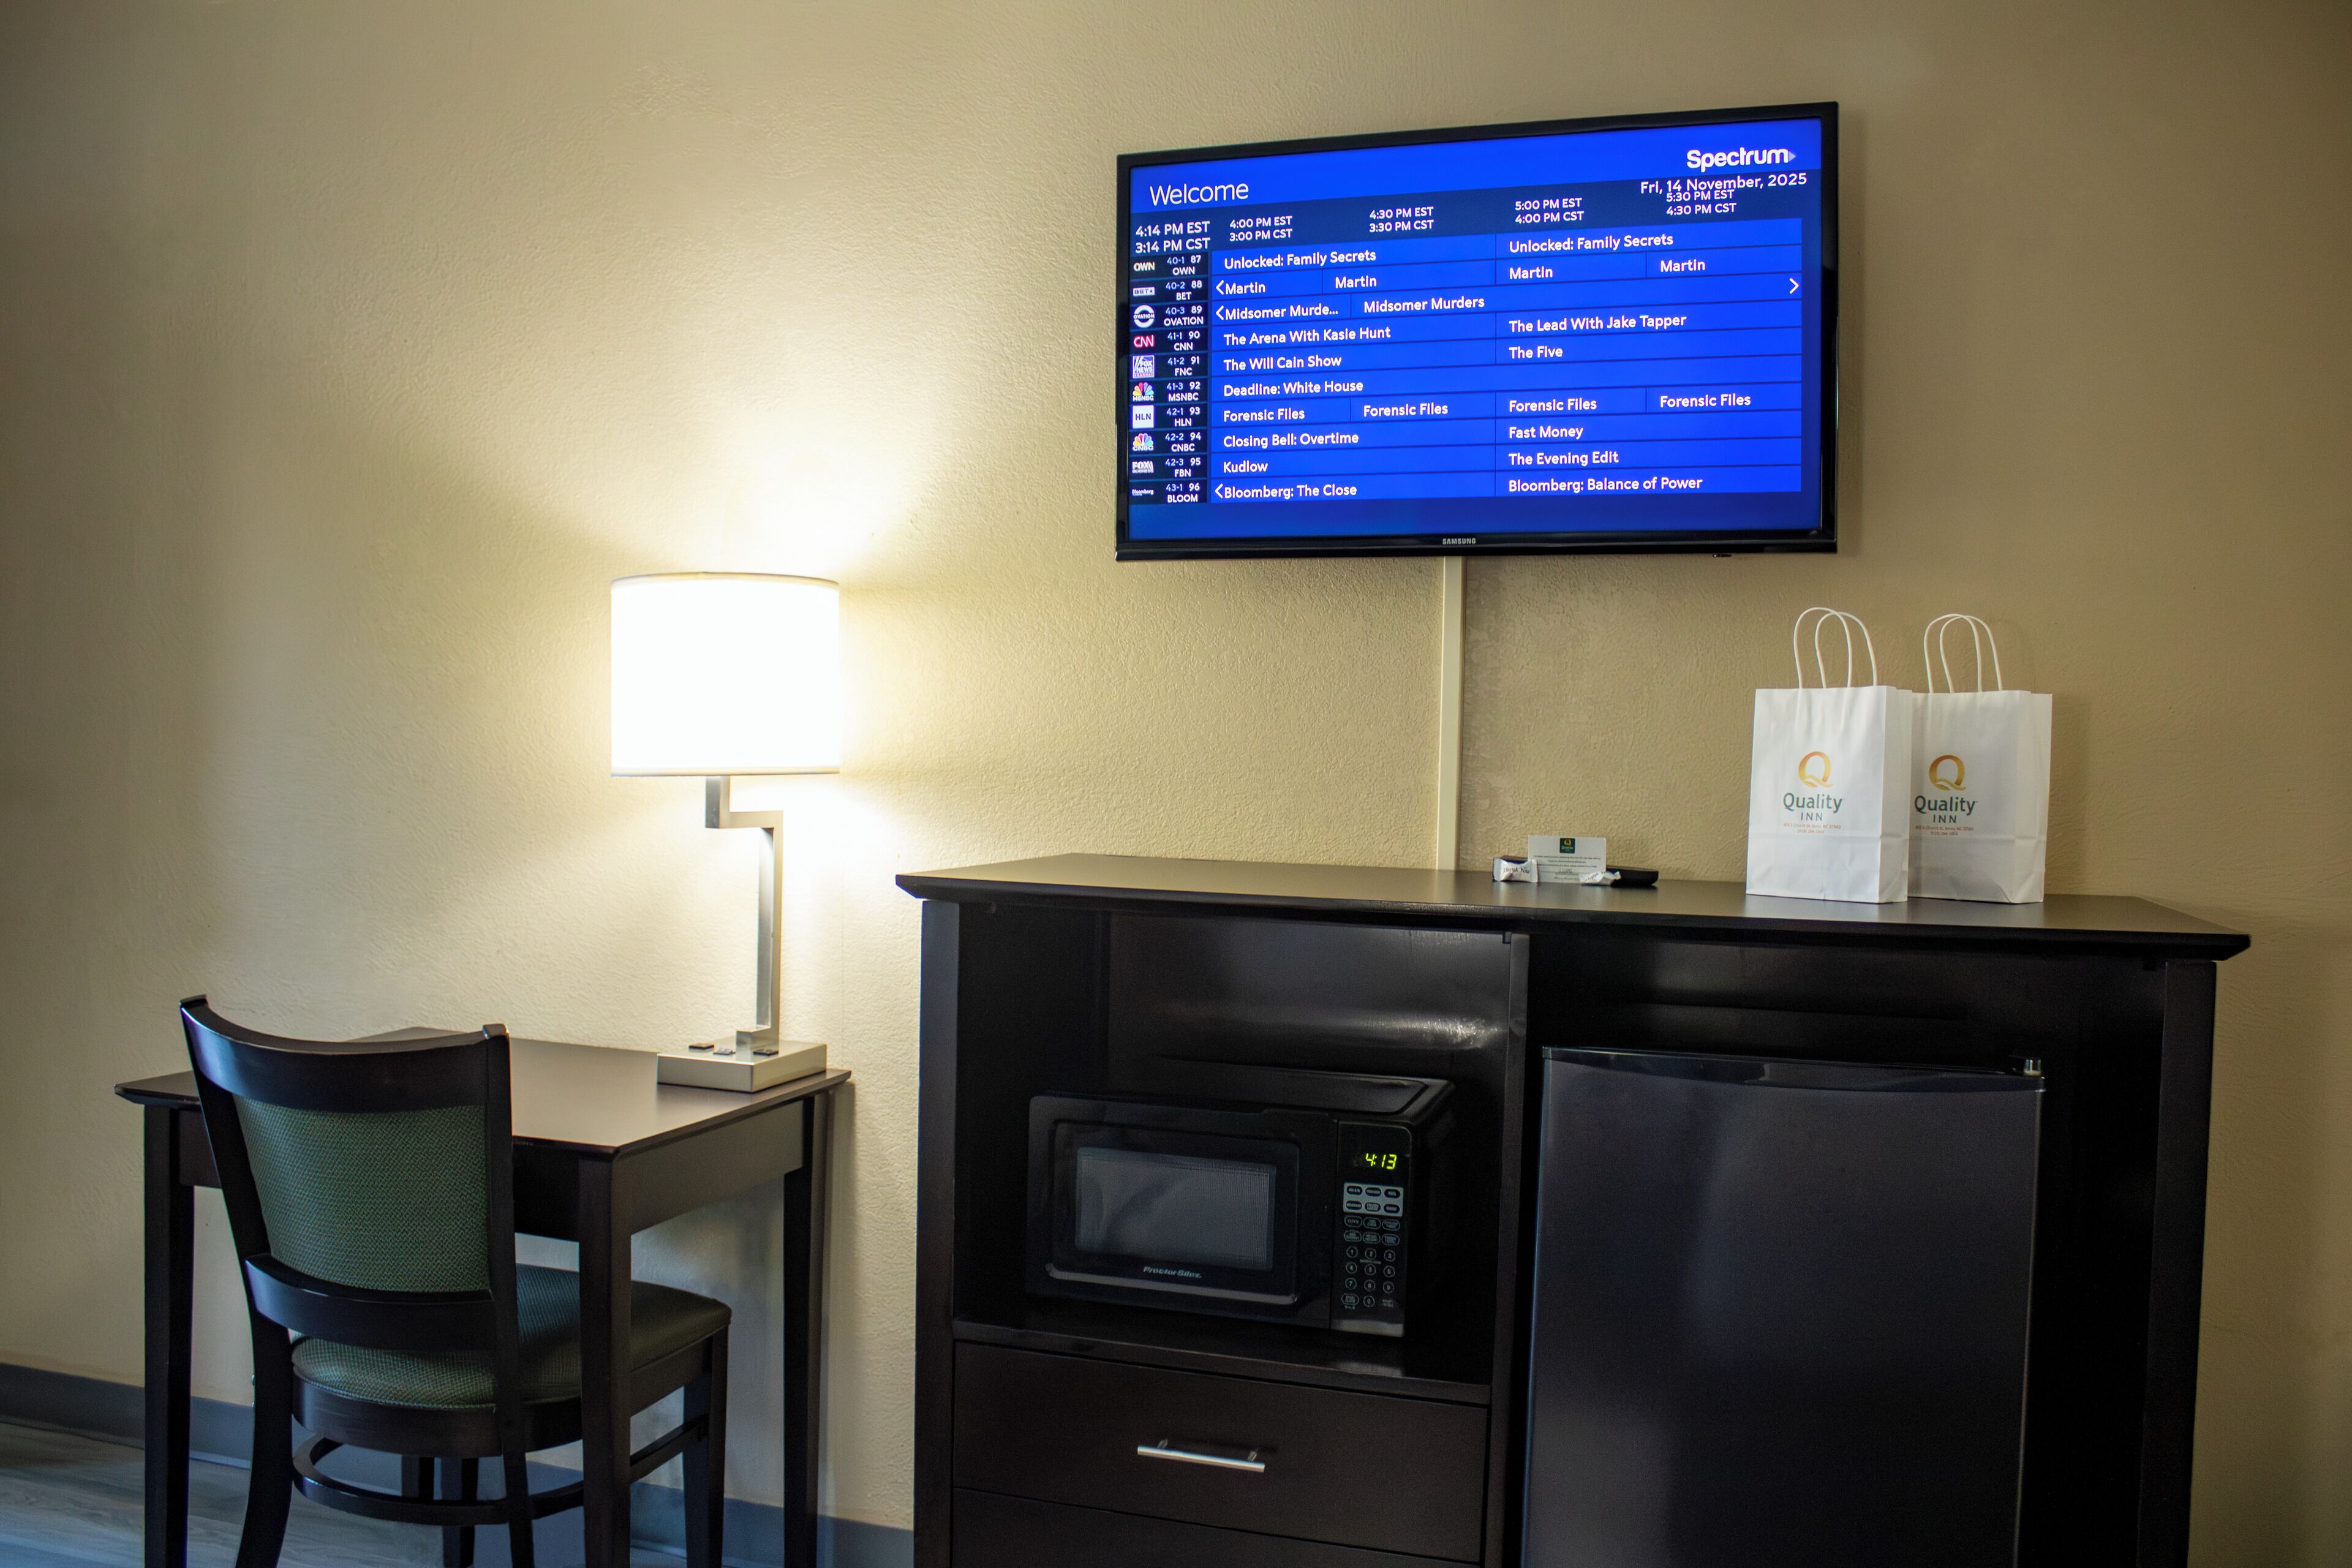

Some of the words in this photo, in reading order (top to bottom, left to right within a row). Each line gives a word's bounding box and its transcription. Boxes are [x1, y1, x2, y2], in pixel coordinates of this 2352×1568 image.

[1687, 147, 1789, 173] Spectrum
[1641, 181, 1662, 195] Fri,
[1667, 179, 1682, 192] 14
[1687, 175, 1763, 191] November,
[1768, 173, 1807, 187] 2025
[1150, 183, 1249, 206] Welcome
[1666, 191, 1691, 202] 5:30
[1694, 190, 1711, 201] PM
[1714, 189, 1735, 200] EST
[1515, 200, 1540, 211] 5:00
[1543, 198, 1559, 209] PM
[1562, 197, 1582, 208] EST
[1666, 205, 1692, 216] 4:30
[1695, 204, 1711, 214] PM
[1714, 203, 1736, 213] CST
[1369, 209, 1393, 219] 4:30
[1396, 208, 1412, 218] PM
[1415, 206, 1434, 217] EST
[1515, 213, 1541, 224] 4:00
[1544, 212, 1560, 223] PM
[1563, 211, 1585, 221] CST
[1229, 218, 1254, 228] 4:00
[1256, 217, 1272, 227] PM
[1274, 216, 1292, 226] EST
[1369, 222, 1392, 233] 3:30
[1395, 221, 1411, 232] PM
[1413, 219, 1434, 230] CST
[1136, 224, 1161, 237] 4:14
[1164, 222, 1183, 235] PM
[1187, 221, 1210, 234] EST
[1229, 231, 1253, 242] 3:00
[1255, 230, 1270, 240] PM
[1273, 228, 1293, 239] CST
[1135, 241, 1159, 254] 3:14
[1163, 239, 1182, 252] PM
[1186, 237, 1211, 250] CST
[1509, 237, 1574, 253] Unlocked:
[1577, 235, 1621, 251] Family
[1624, 233, 1673, 247] Secrets
[1167, 256, 1185, 265] 40-1
[1190, 255, 1201, 264] 87
[1224, 254, 1284, 270] Unlocked:
[1287, 251, 1327, 266] Family
[1330, 249, 1376, 263] Secrets
[1660, 258, 1705, 273] Martin
[1133, 262, 1155, 271] OWN
[1172, 266, 1196, 276] OWN
[1509, 266, 1553, 279] Martin
[1165, 281, 1185, 290] 40-2
[1191, 280, 1202, 288] 88
[1335, 275, 1377, 288] Martin
[1226, 282, 1265, 295] Martin
[1176, 292, 1192, 301] BET
[1165, 306, 1185, 315] 40-3
[1191, 305, 1202, 314] 89
[1364, 300, 1428, 313] Midsomer
[1431, 295, 1485, 310] Murders
[1226, 307, 1287, 320] Midsomer
[1290, 303, 1338, 317] Murde...
[1164, 316, 1204, 326] OVATION
[1509, 319, 1534, 333] The
[1537, 317, 1567, 331] Lead
[1570, 316, 1604, 330] With
[1607, 315, 1637, 329] Jake
[1639, 315, 1687, 330] Tapper
[1134, 334, 1155, 348] CNN
[1167, 332, 1183, 341] 41-1
[1188, 331, 1200, 340] 90
[1223, 333, 1246, 345] The
[1249, 333, 1286, 345] Arena
[1289, 329, 1320, 342] With
[1324, 328, 1356, 341] Kasie
[1360, 326, 1391, 339] Hunt
[1174, 342, 1193, 351] CNN
[1509, 346, 1534, 359] The
[1537, 345, 1563, 358] Five
[1167, 357, 1185, 366] 41-2
[1191, 356, 1200, 365] 91
[1223, 358, 1246, 371] The
[1249, 356, 1273, 370] Will
[1276, 356, 1304, 369] Cain
[1307, 354, 1342, 368] Show
[1175, 368, 1193, 376] FNC
[1189, 381, 1201, 390] 92
[1224, 383, 1280, 397] Deadline:
[1283, 381, 1321, 394] White
[1324, 380, 1363, 393] House
[1168, 393, 1199, 402] MSNBC
[1660, 394, 1717, 408] Forensic
[1721, 393, 1751, 406] Files
[1166, 407, 1183, 416] 42-1
[1189, 407, 1200, 416] 93
[1363, 404, 1416, 417] Forensic
[1420, 402, 1448, 415] Files
[1509, 399, 1564, 412] Forensic
[1567, 398, 1597, 410] Files
[1224, 409, 1274, 422] Forensic
[1278, 407, 1305, 420] Files
[1174, 418, 1192, 427] HLN
[1165, 432, 1184, 441] 42-2
[1190, 432, 1202, 441] 94
[1509, 426, 1536, 439] Fast
[1539, 425, 1584, 440] Money
[1223, 435, 1268, 449] Closing
[1272, 433, 1297, 446] Bell:
[1300, 432, 1359, 445] Overtime
[1171, 443, 1196, 453] CNBC
[1165, 458, 1184, 467] 42-3
[1190, 457, 1201, 466] 95
[1508, 452, 1533, 466] The
[1537, 452, 1588, 467] Evening
[1592, 450, 1619, 464] Edit
[1132, 461, 1150, 470] FOX
[1223, 460, 1268, 473] Kudlow
[1174, 469, 1191, 478] FBN
[1166, 483, 1183, 492] 43-1
[1189, 482, 1200, 492] 96
[1224, 484, 1294, 500] Bloomberg:
[1296, 484, 1320, 497] The
[1323, 483, 1357, 496] Close
[1509, 478, 1584, 494] Bloomberg:
[1588, 477, 1640, 491] Balance
[1643, 477, 1657, 489] of
[1661, 477, 1703, 489] Power
[1167, 494, 1198, 503] BLOOM
[1783, 792, 1843, 813] Quality
[1914, 795, 1975, 816] Quality
[1801, 812, 1823, 821] INN
[1933, 814, 1956, 824] INN
[1366, 1153, 1396, 1169] 4:13
